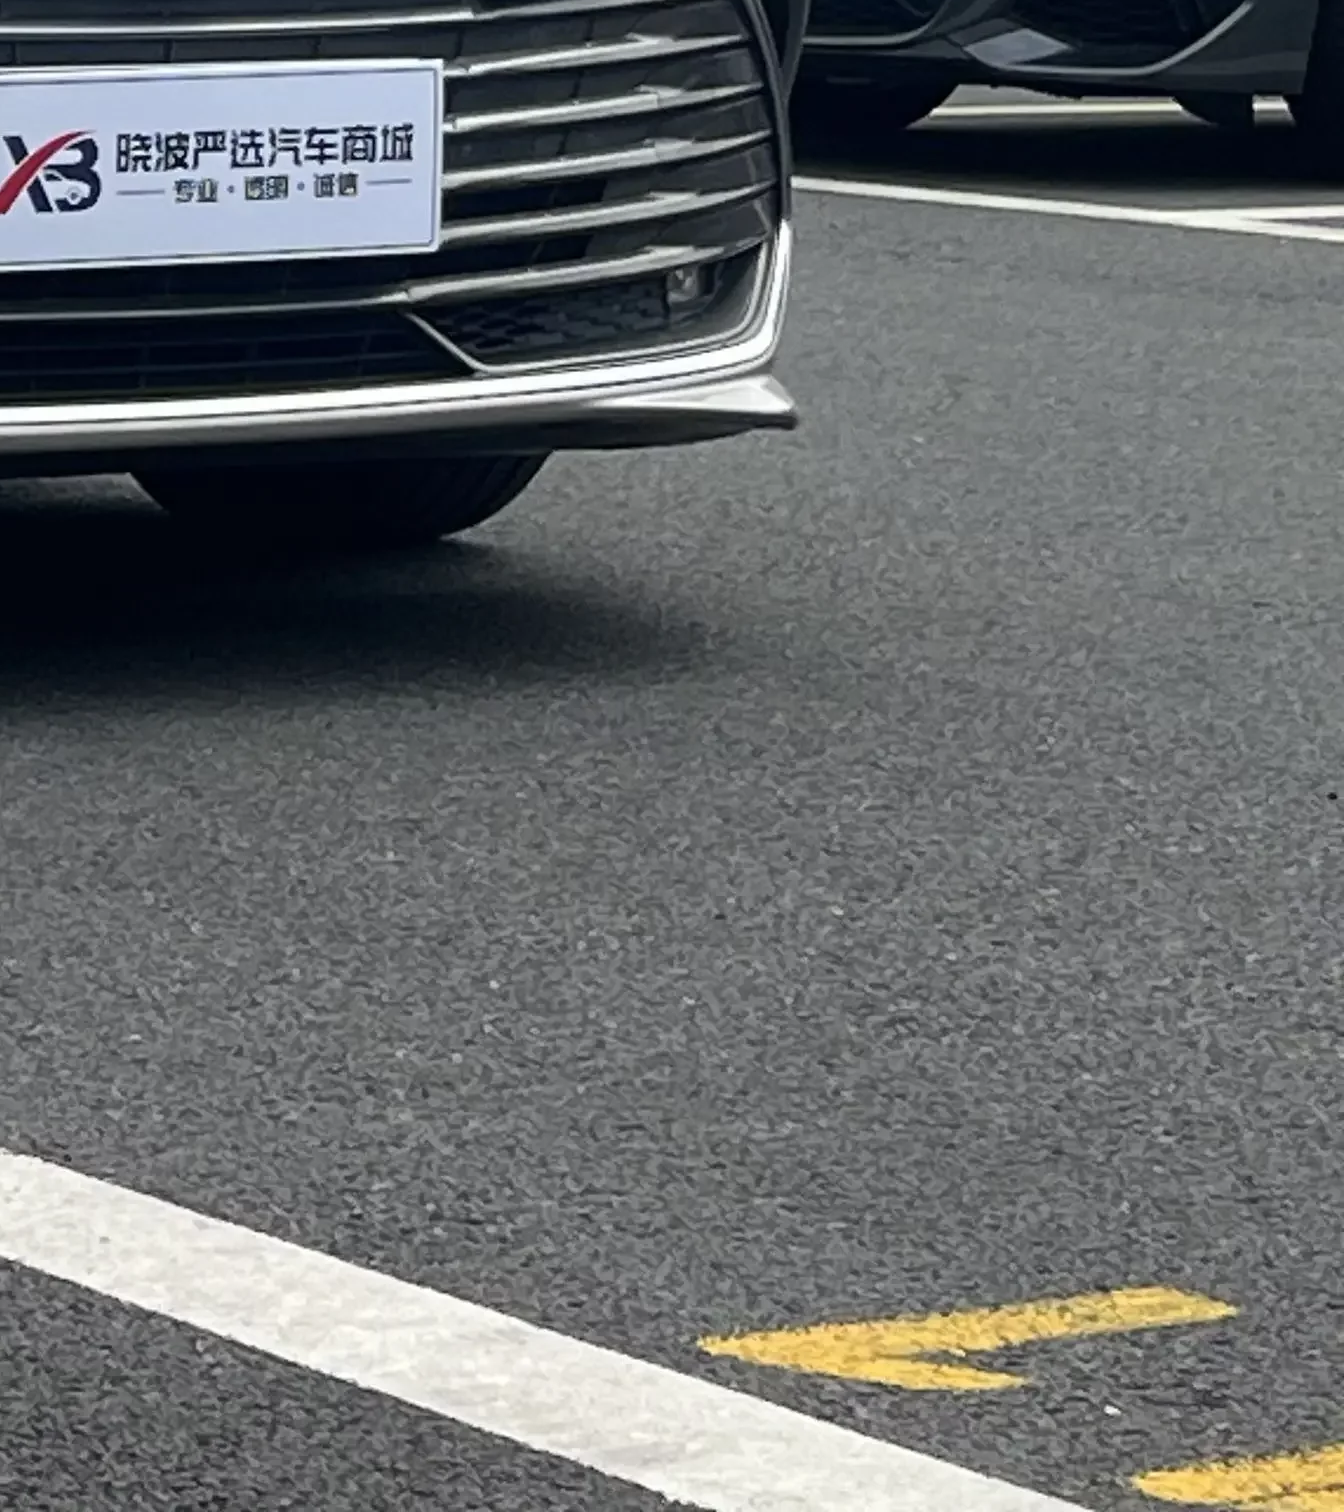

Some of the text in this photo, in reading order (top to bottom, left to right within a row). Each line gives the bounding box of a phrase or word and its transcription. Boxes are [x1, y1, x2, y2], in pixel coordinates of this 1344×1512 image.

[115, 123, 414, 172] 晓波严选汽车商城
